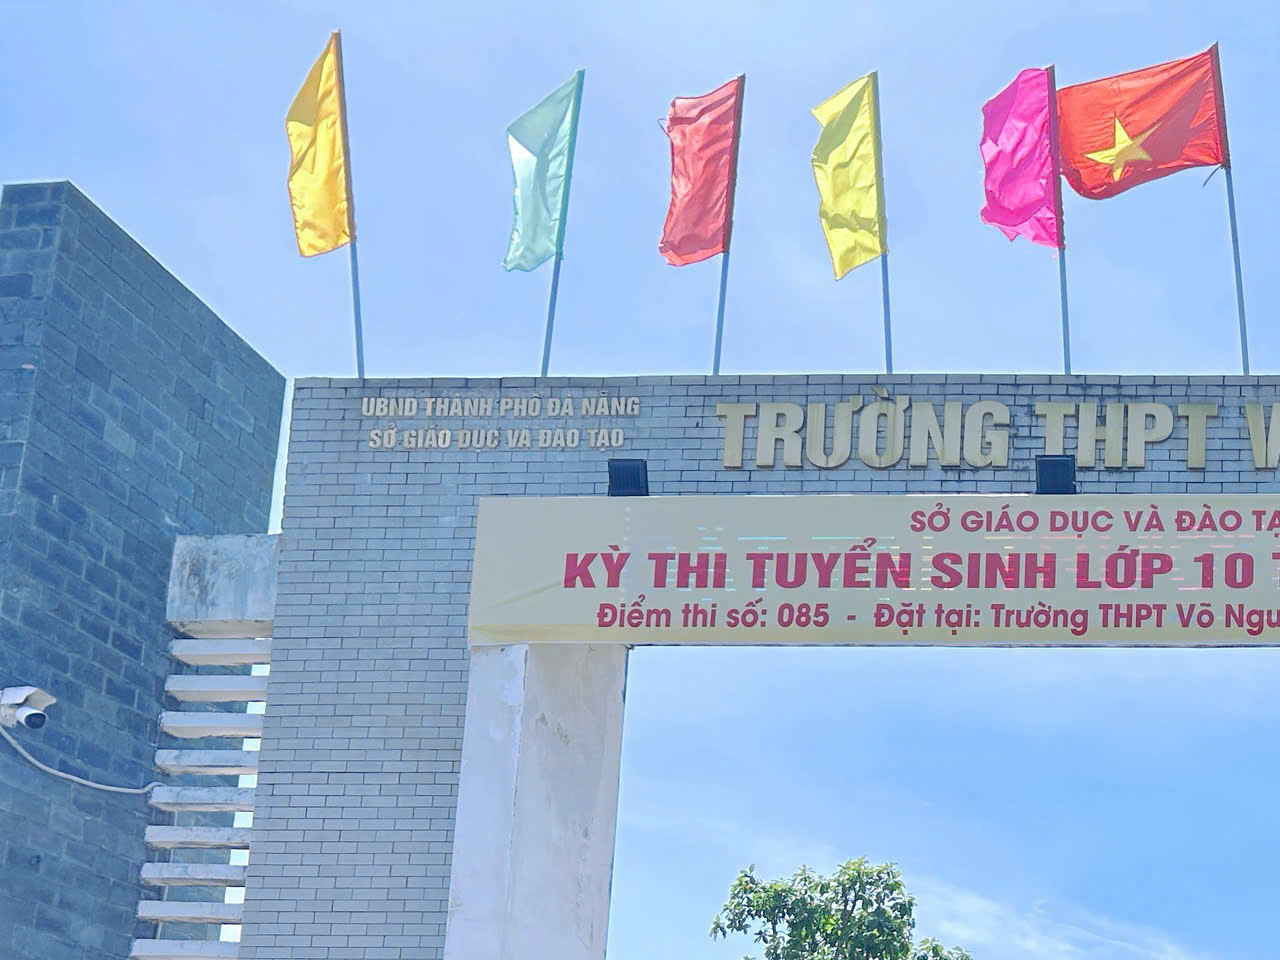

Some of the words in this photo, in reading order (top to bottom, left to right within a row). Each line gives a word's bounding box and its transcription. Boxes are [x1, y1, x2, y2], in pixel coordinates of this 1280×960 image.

[361, 397, 419, 417] UBND
[424, 391, 493, 417] THÀNH
[546, 392, 575, 417] ĐÀ
[581, 389, 641, 416] NẴNG
[368, 422, 397, 449] SỞ
[403, 424, 451, 449] GIÁO
[458, 428, 500, 453] DỤC
[506, 424, 531, 448] VÀ
[587, 427, 625, 452] TẠO
[716, 386, 1012, 469] TRƯỜNG
[1035, 398, 1218, 469] THPT
[910, 502, 951, 533] SỞ
[960, 503, 1040, 533] GIÁO
[1049, 509, 1114, 539] DỤC
[1123, 504, 1165, 533] VÀ
[1174, 503, 1243, 533] ĐÀO
[563, 544, 631, 590] KỲ
[647, 552, 728, 589] THI
[746, 537, 912, 590] TUYỂN
[930, 551, 1057, 590] SINH
[1075, 544, 1174, 590] LỚP
[1193, 552, 1255, 590] 10
[597, 594, 671, 628] Điểm
[681, 603, 717, 628] thi
[727, 597, 767, 628] số:
[777, 603, 830, 628] 085
[874, 602, 926, 636] Đặt
[935, 603, 980, 636] tại:
[990, 602, 1089, 637] Trường
[1098, 603, 1167, 628] THPT
[1176, 603, 1214, 629] Võ
